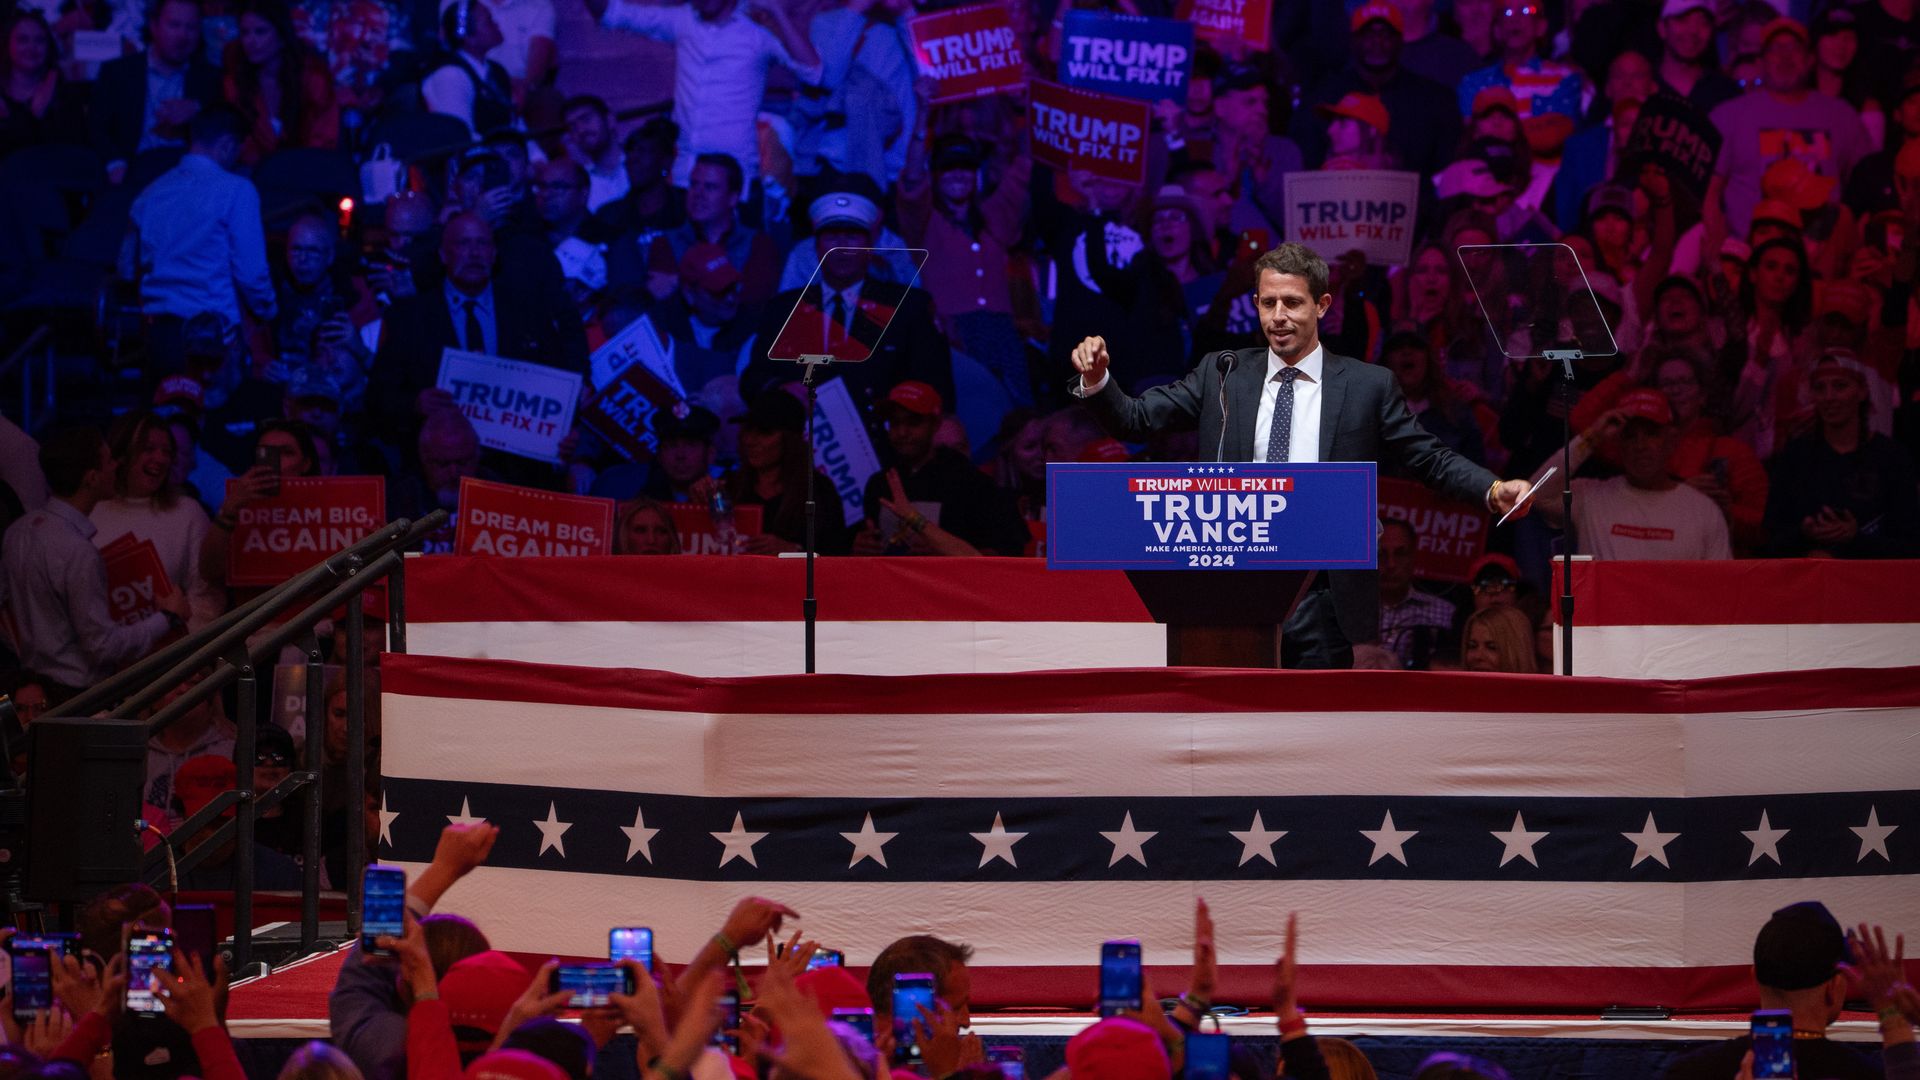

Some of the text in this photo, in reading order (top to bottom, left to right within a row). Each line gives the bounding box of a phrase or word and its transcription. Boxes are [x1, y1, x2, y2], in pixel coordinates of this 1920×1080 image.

[922, 27, 1015, 64] TRUMP
[1068, 36, 1188, 70] TRUMP
[980, 54, 1009, 71] FIX
[1010, 50, 1023, 66] IT
[1068, 62, 1184, 87] WILL FIX IT
[1032, 101, 1142, 146] TRUMP
[1033, 126, 1138, 164] WILL FIX IT
[1298, 200, 1406, 224] TRUMP
[1299, 224, 1402, 240] WILL FIX IT
[450, 379, 562, 419] TRUMP
[501, 412, 530, 432] FIX
[537, 420, 556, 437] IT
[602, 395, 639, 438] WILL
[812, 403, 864, 509] TRUMP
[1136, 479, 1287, 491] TRUMP WILL FIX IT
[239, 506, 375, 527] DREAM BIG,
[1136, 494, 1287, 521] TRUMP
[470, 509, 549, 533] DREAM
[556, 523, 601, 547] BIG,
[1153, 522, 1270, 543] VANCE
[1417, 535, 1476, 557] FIX IT
[1188, 554, 1235, 567] 2024
